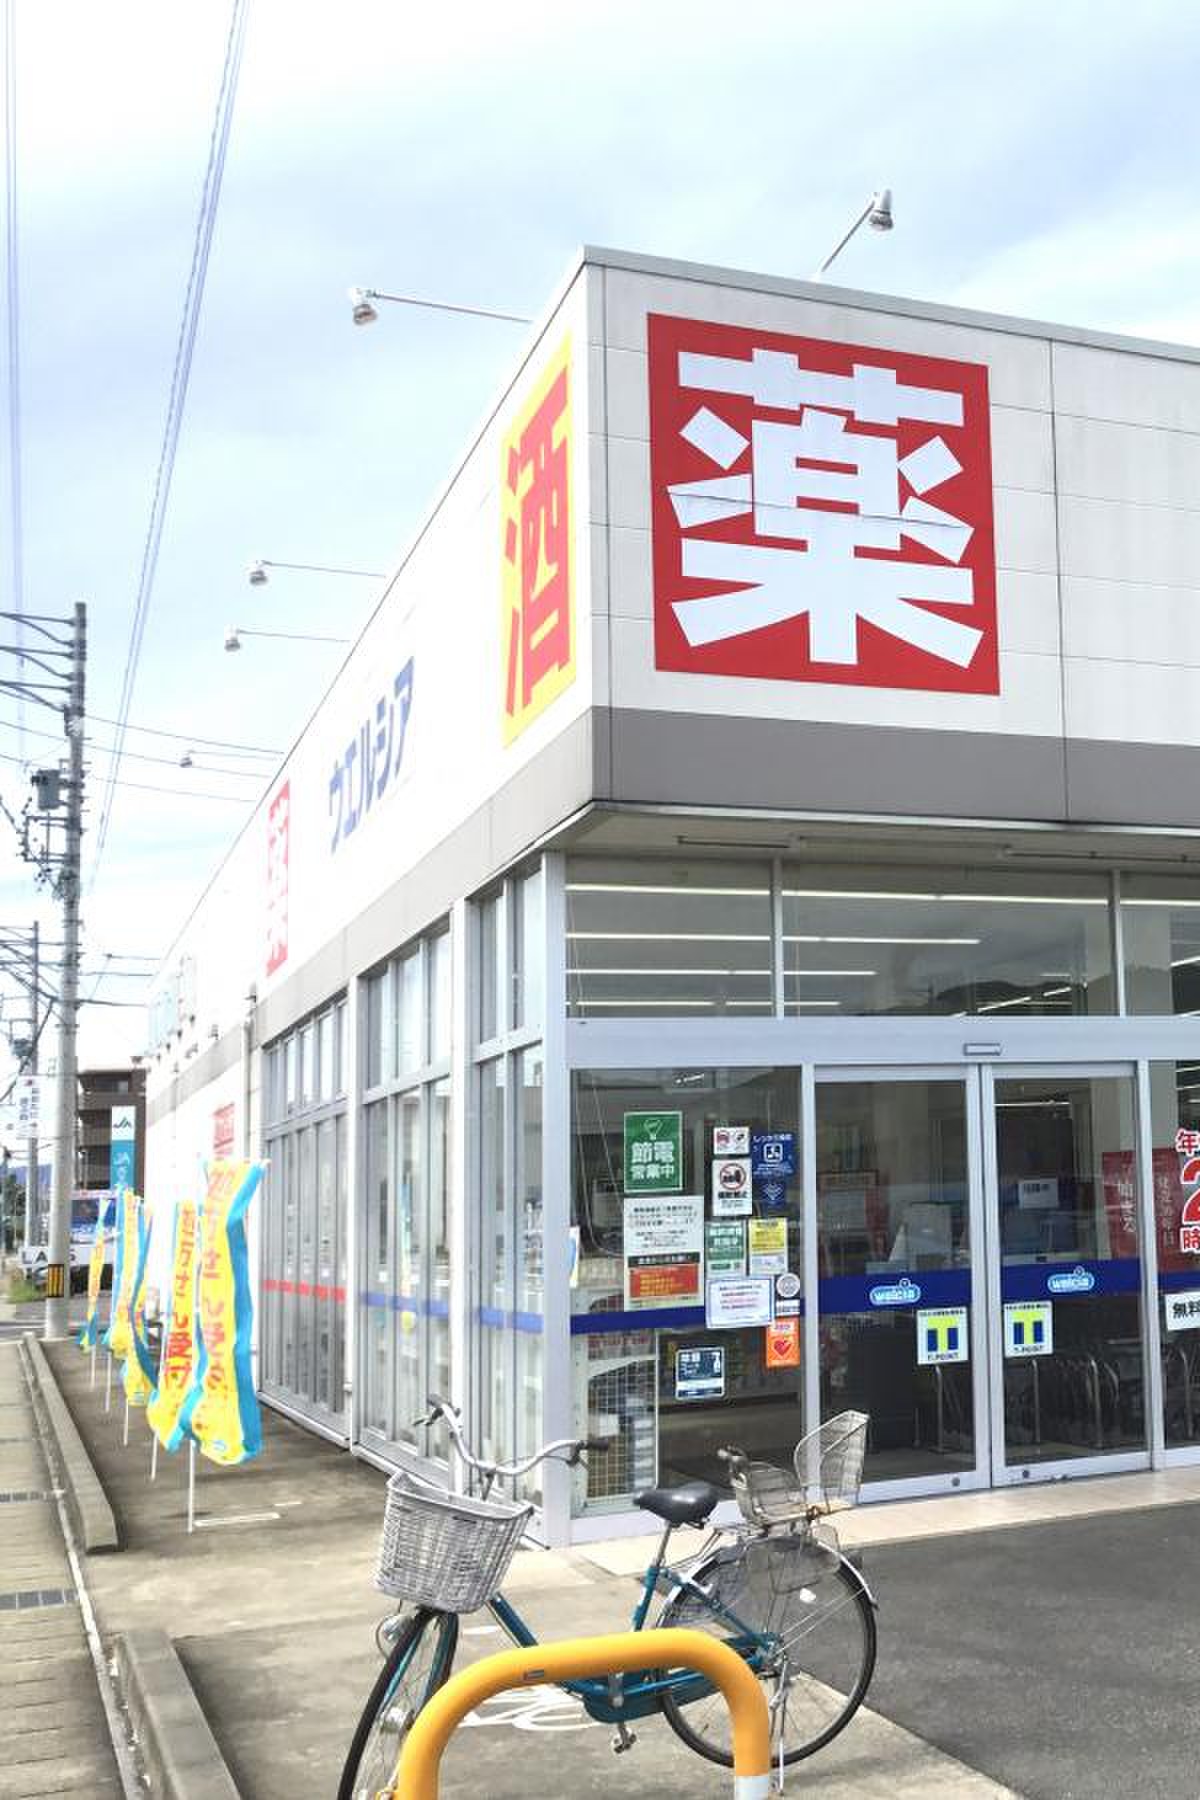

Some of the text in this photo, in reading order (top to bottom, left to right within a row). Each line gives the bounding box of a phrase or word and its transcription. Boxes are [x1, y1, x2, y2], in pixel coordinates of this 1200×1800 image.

[505, 365, 569, 718] 酒
[667, 348, 984, 669] 薬
[631, 1141, 675, 1163] 節電
[631, 1164, 675, 1181] 営業中
